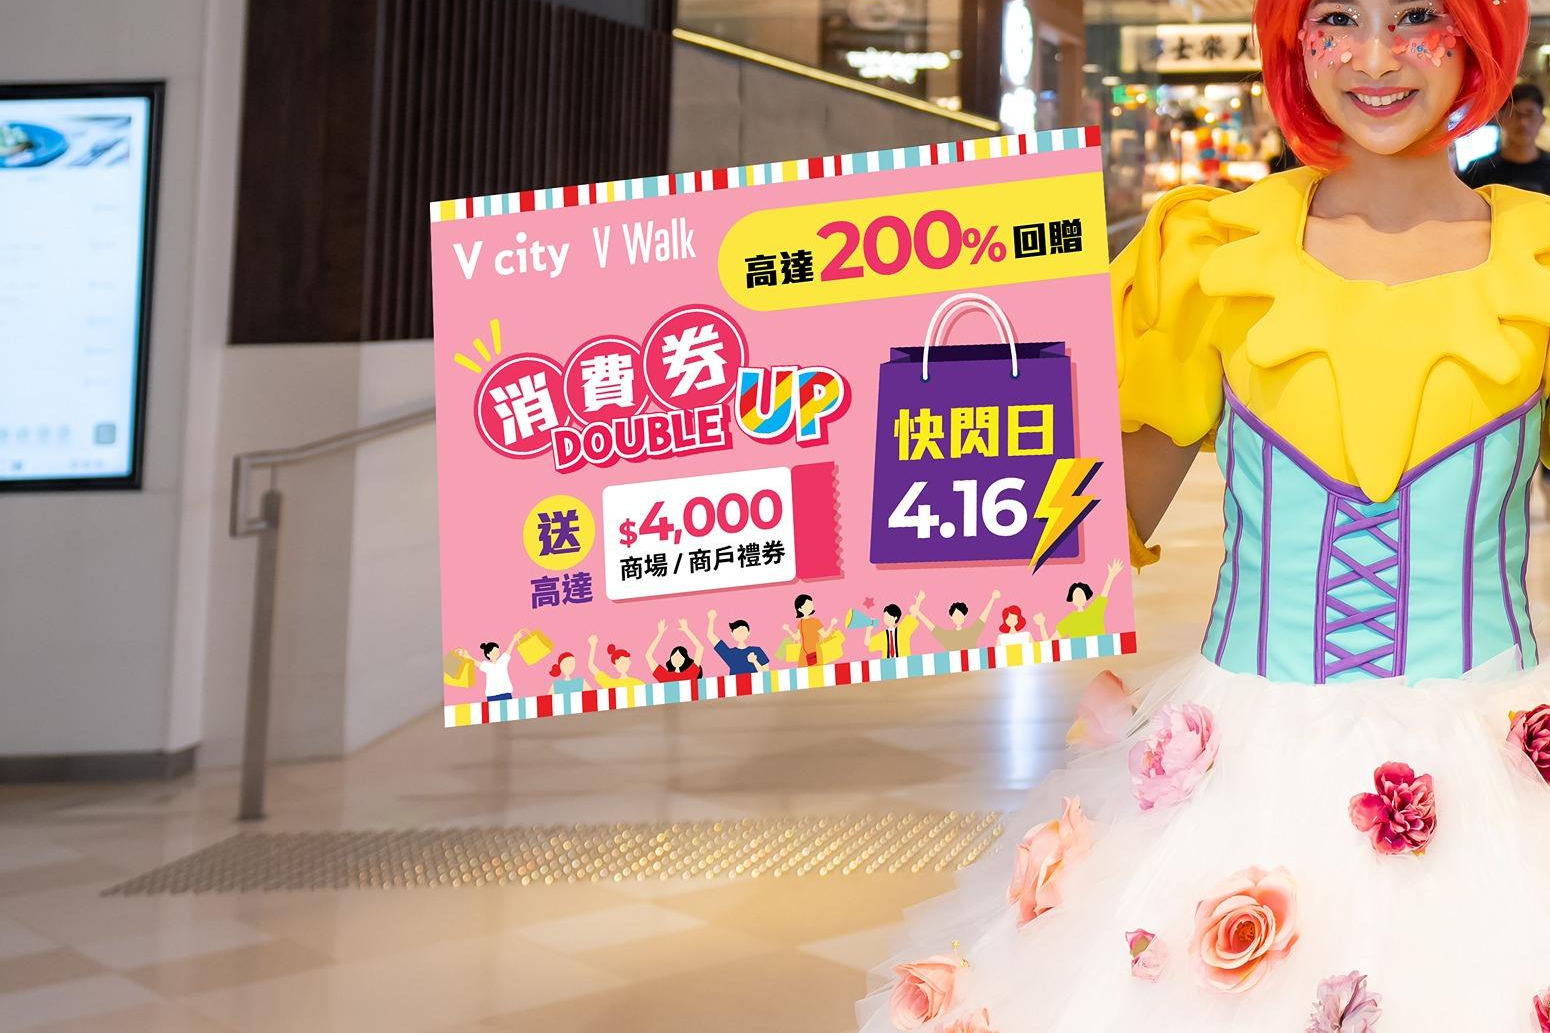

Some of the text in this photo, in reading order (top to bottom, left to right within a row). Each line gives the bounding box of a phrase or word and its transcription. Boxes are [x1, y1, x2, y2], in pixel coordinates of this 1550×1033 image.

[453, 231, 570, 280] V city
[592, 217, 697, 269] V Walk
[816, 209, 1008, 284] 200%
[550, 365, 847, 471] DOUBLE UP
[894, 405, 1055, 463] 快閃日
[537, 508, 582, 557] 送
[619, 488, 783, 549] $4,000
[887, 478, 1029, 541] 4.16
[530, 571, 595, 609] 高達
